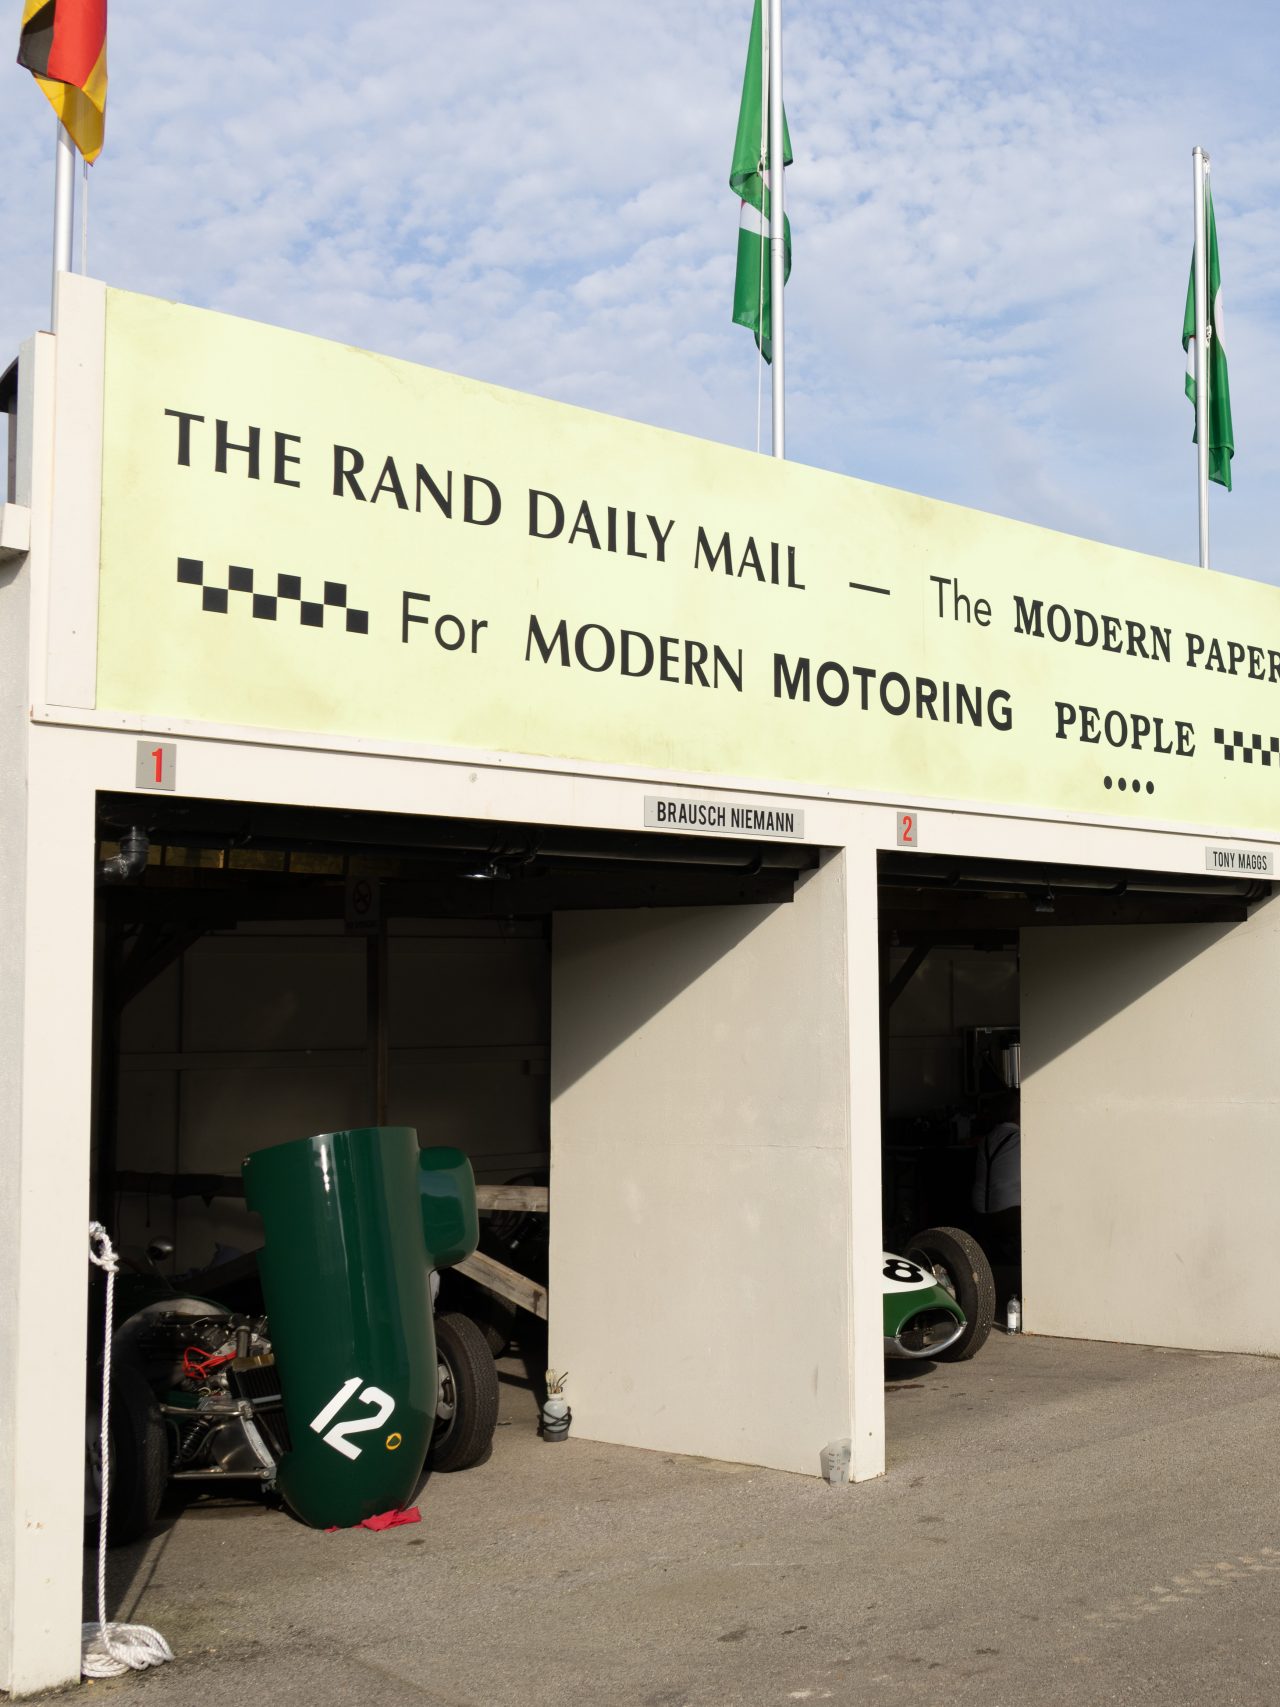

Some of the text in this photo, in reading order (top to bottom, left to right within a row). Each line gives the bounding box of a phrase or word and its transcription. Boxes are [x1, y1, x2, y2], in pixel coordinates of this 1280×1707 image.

[164, 406, 302, 489] THE
[331, 443, 503, 527] RAND
[527, 487, 676, 563] DAILY
[693, 525, 806, 591] MAIL
[929, 574, 993, 628] The
[1013, 595, 1173, 663] MODERN
[400, 590, 1197, 758] For MODERN MOTORING PEOPLE
[151, 748, 163, 783] 1
[655, 801, 795, 834] BRAUSCH NIEMANN
[903, 815, 914, 842] 2
[1213, 852, 1268, 871] TONY MAGGS
[883, 1259, 924, 1283] 8
[309, 1376, 396, 1461] 12
